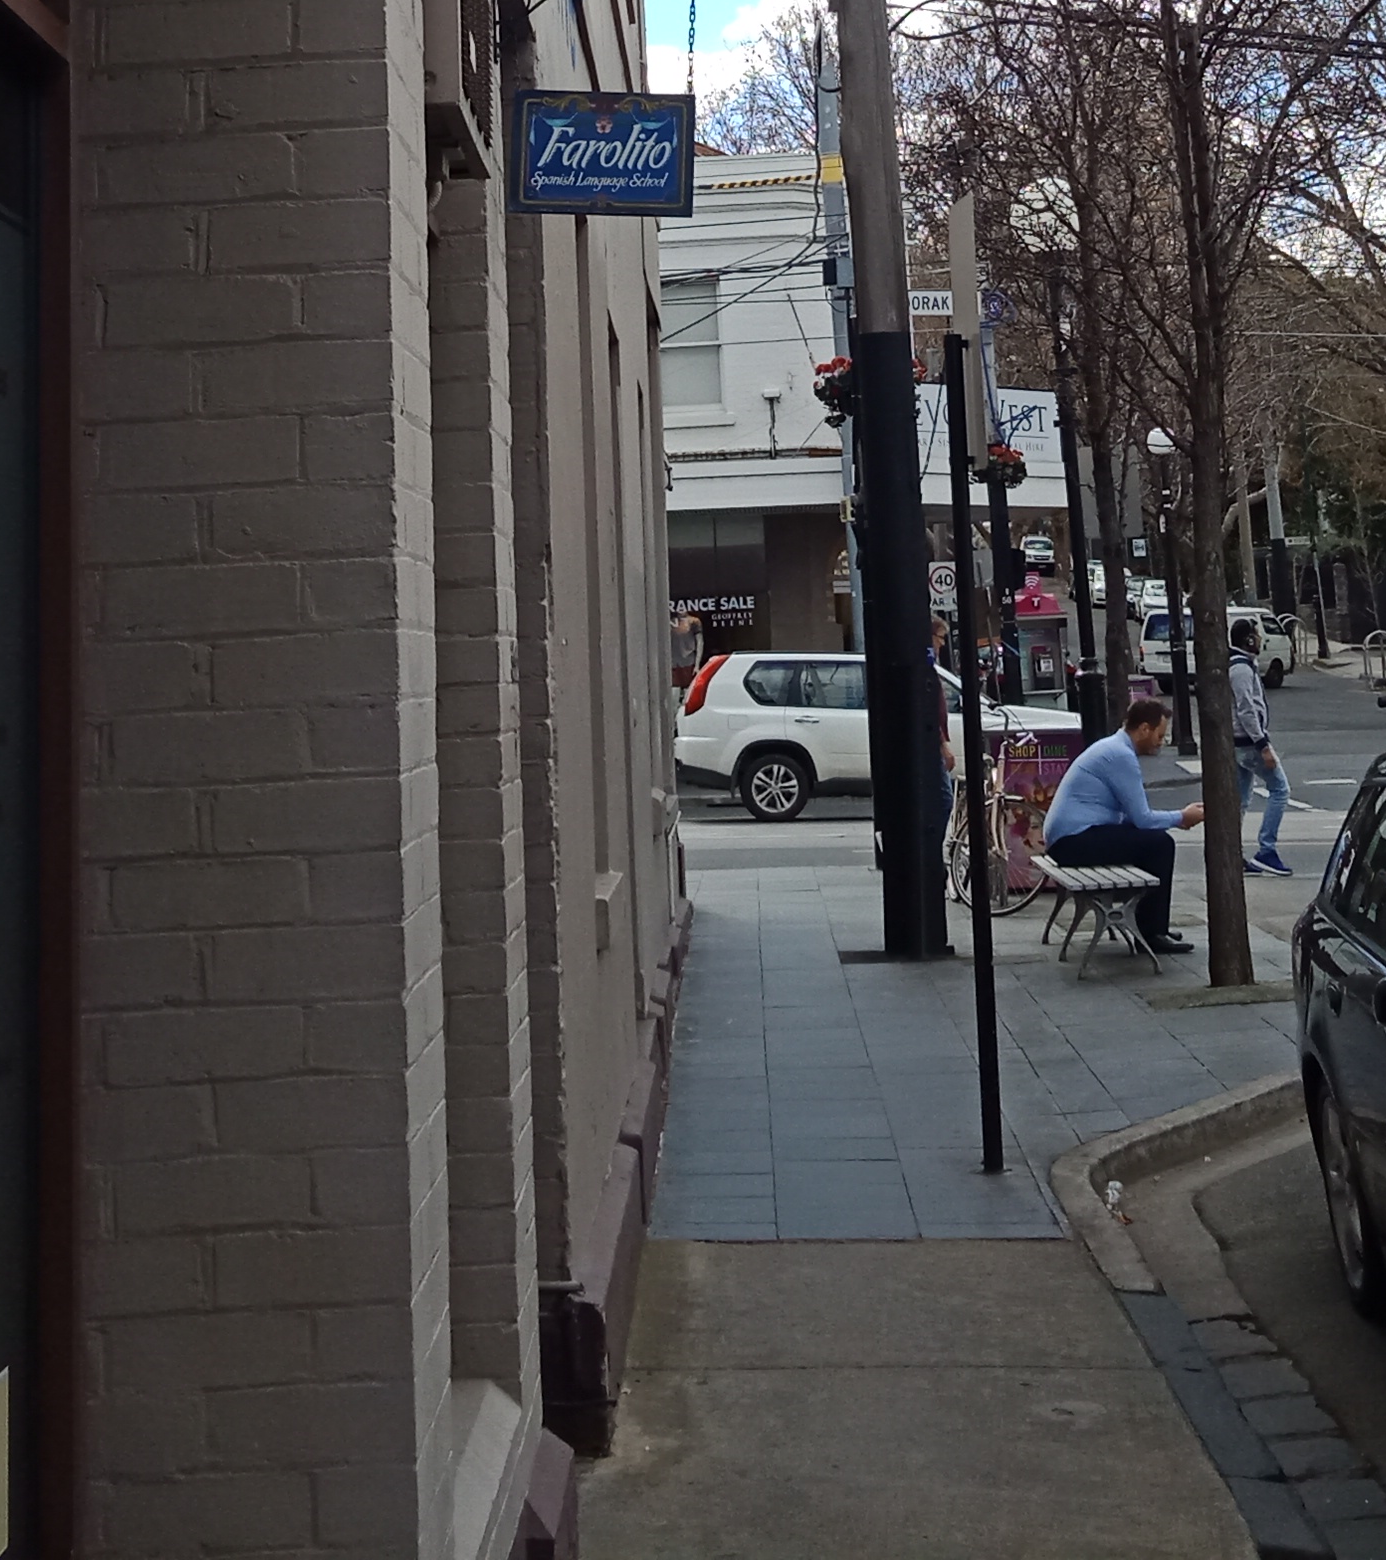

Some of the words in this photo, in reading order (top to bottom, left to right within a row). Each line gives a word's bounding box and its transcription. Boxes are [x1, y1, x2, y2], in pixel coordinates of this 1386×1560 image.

[537, 124, 672, 170] Farolito
[530, 170, 574, 190] Spanish
[575, 171, 628, 192] Language
[629, 172, 669, 188] School
[935, 574, 953, 587] 40
[720, 596, 755, 609] SALE
[1008, 746, 1036, 757] SHOP
